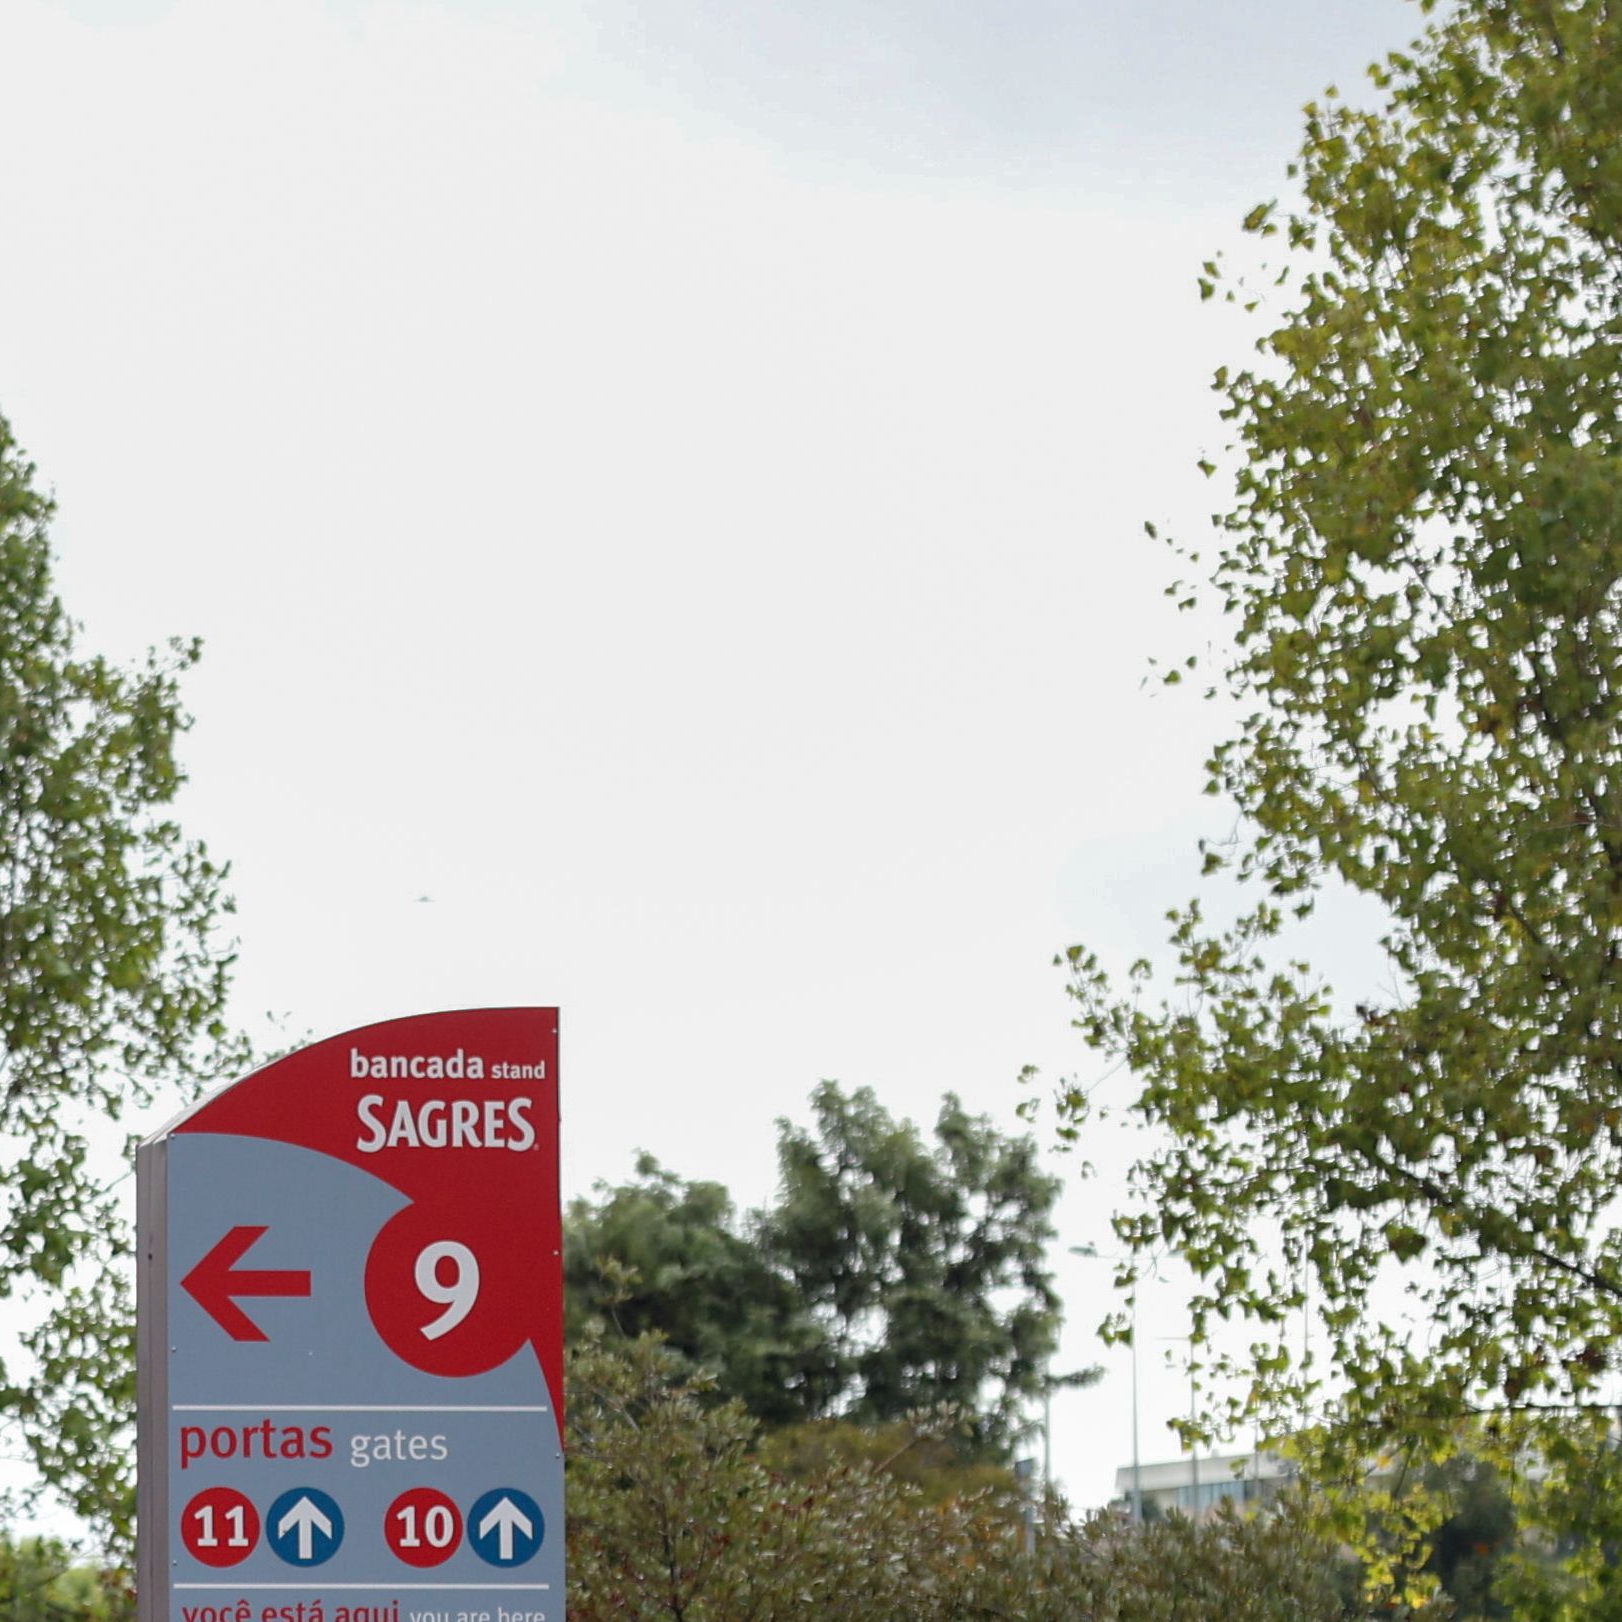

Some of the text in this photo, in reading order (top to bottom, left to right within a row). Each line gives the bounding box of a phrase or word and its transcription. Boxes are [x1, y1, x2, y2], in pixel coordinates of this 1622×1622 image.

[350, 1048, 546, 1079] bancada stand
[356, 1094, 536, 1152] SAGRES
[414, 1240, 480, 1341] 9
[180, 1419, 448, 1469] portas gates
[193, 1505, 250, 1548] 11
[396, 1505, 454, 1548] 10
